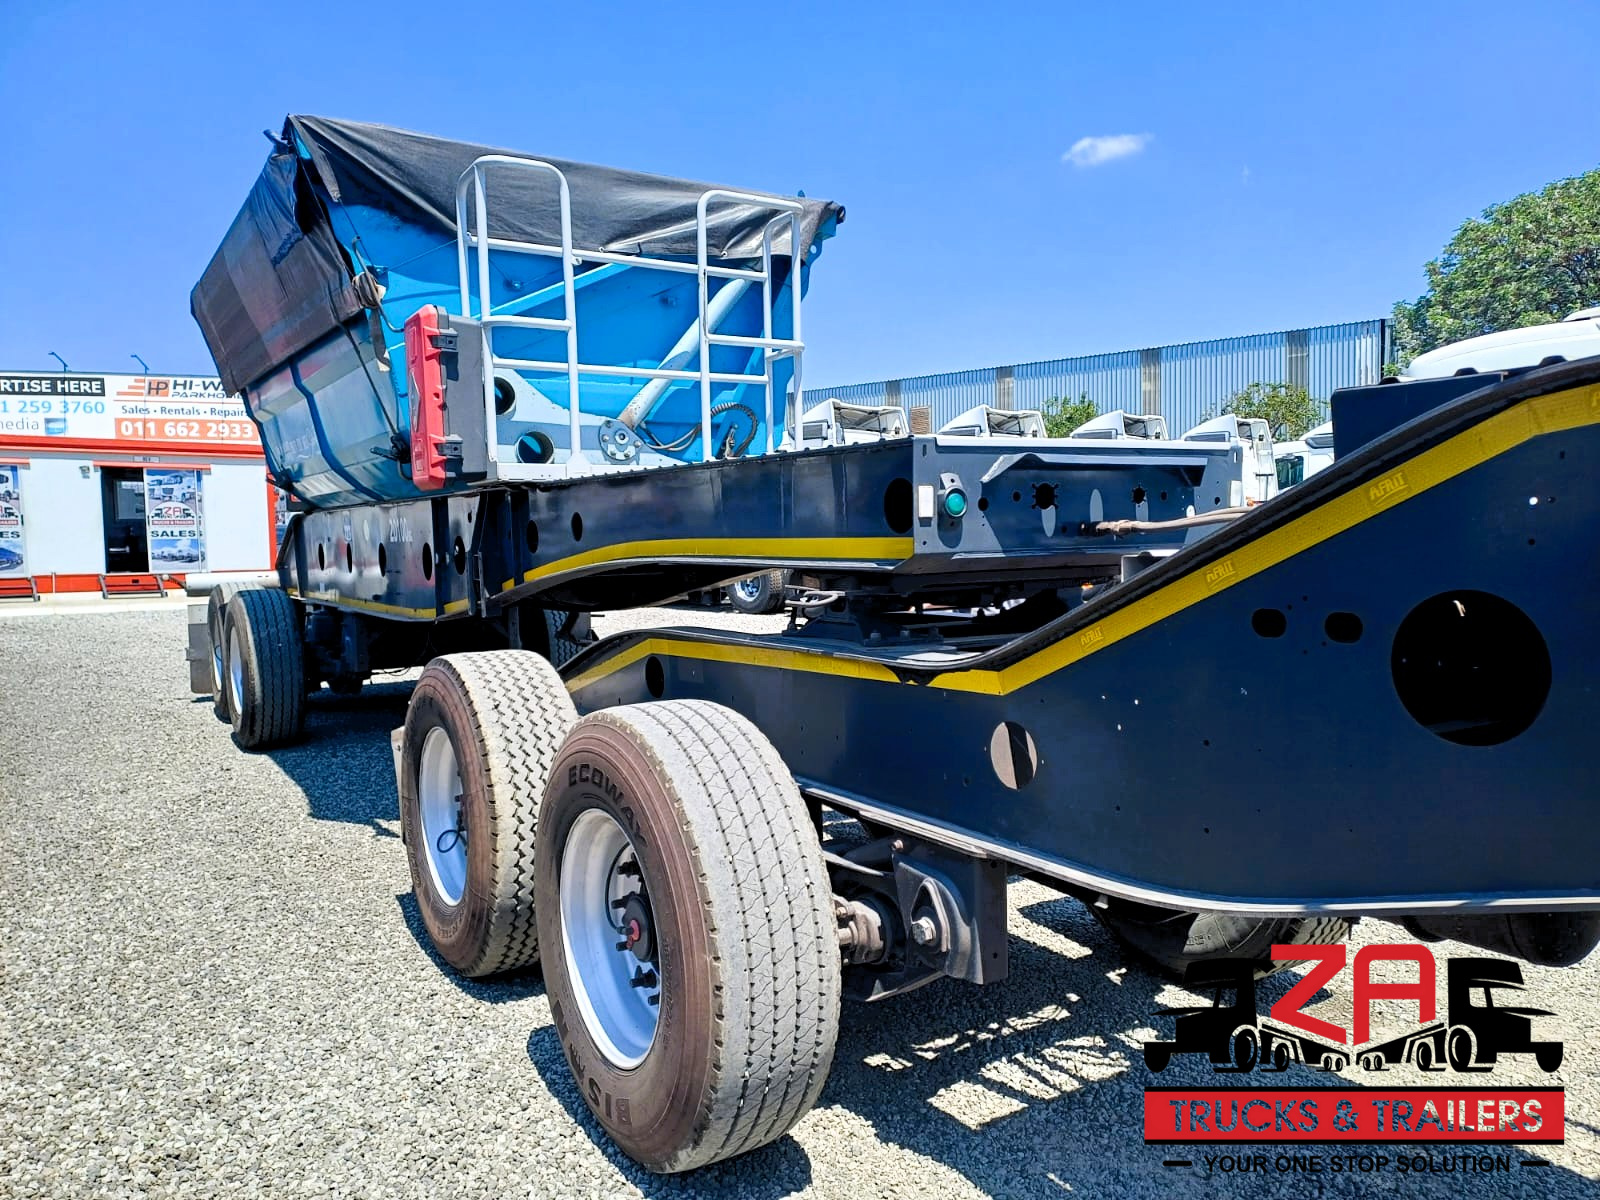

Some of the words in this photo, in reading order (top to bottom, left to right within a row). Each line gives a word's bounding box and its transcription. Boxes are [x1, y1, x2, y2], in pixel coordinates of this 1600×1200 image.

[57, 380, 102, 393] HERE
[18, 400, 52, 414] 259
[60, 401, 105, 414] 3760
[121, 405, 151, 415] Sales
[160, 406, 201, 416] Rentals
[120, 420, 157, 437] 011
[164, 421, 200, 438] 662
[206, 422, 253, 438] 2933
[1369, 472, 1406, 501] AFRIT
[150, 530, 196, 538] SALES
